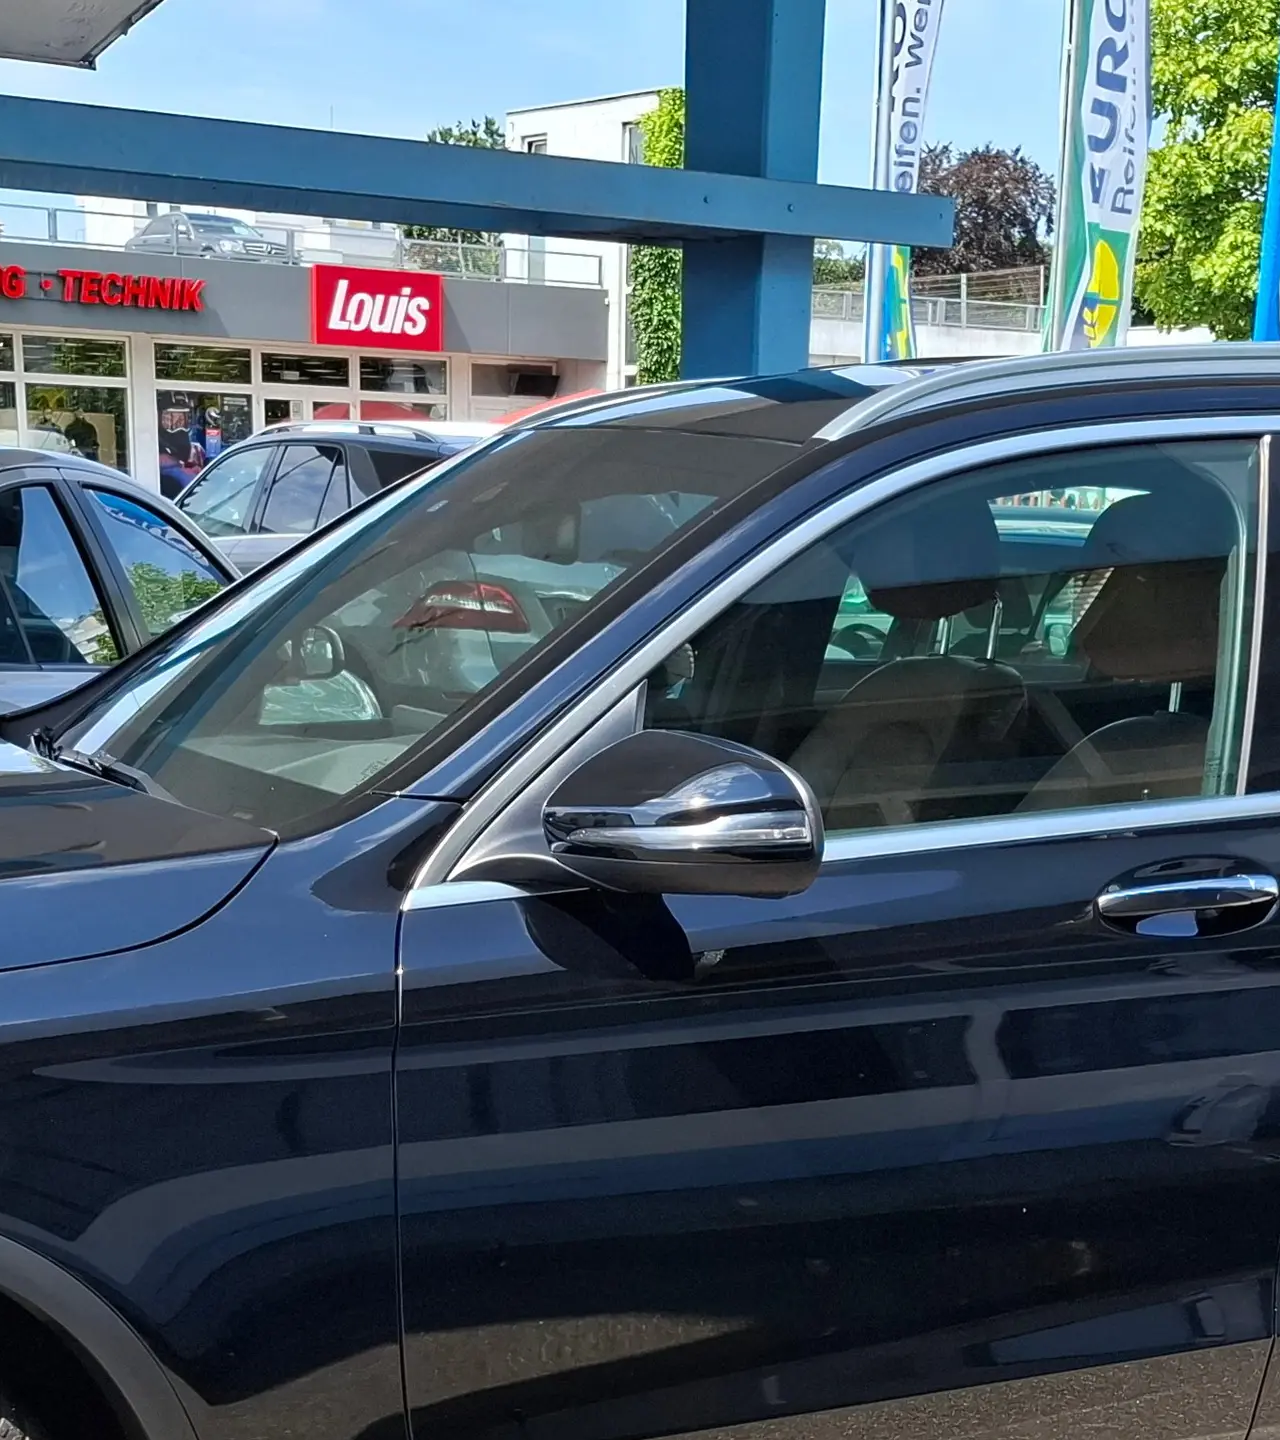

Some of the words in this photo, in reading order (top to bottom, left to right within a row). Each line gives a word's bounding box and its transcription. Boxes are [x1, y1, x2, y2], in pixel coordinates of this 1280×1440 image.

[905, 0, 931, 68] We
[893, 87, 921, 193] eifen.
[58, 269, 206, 312] TECHNIK
[328, 279, 430, 336] Louis
